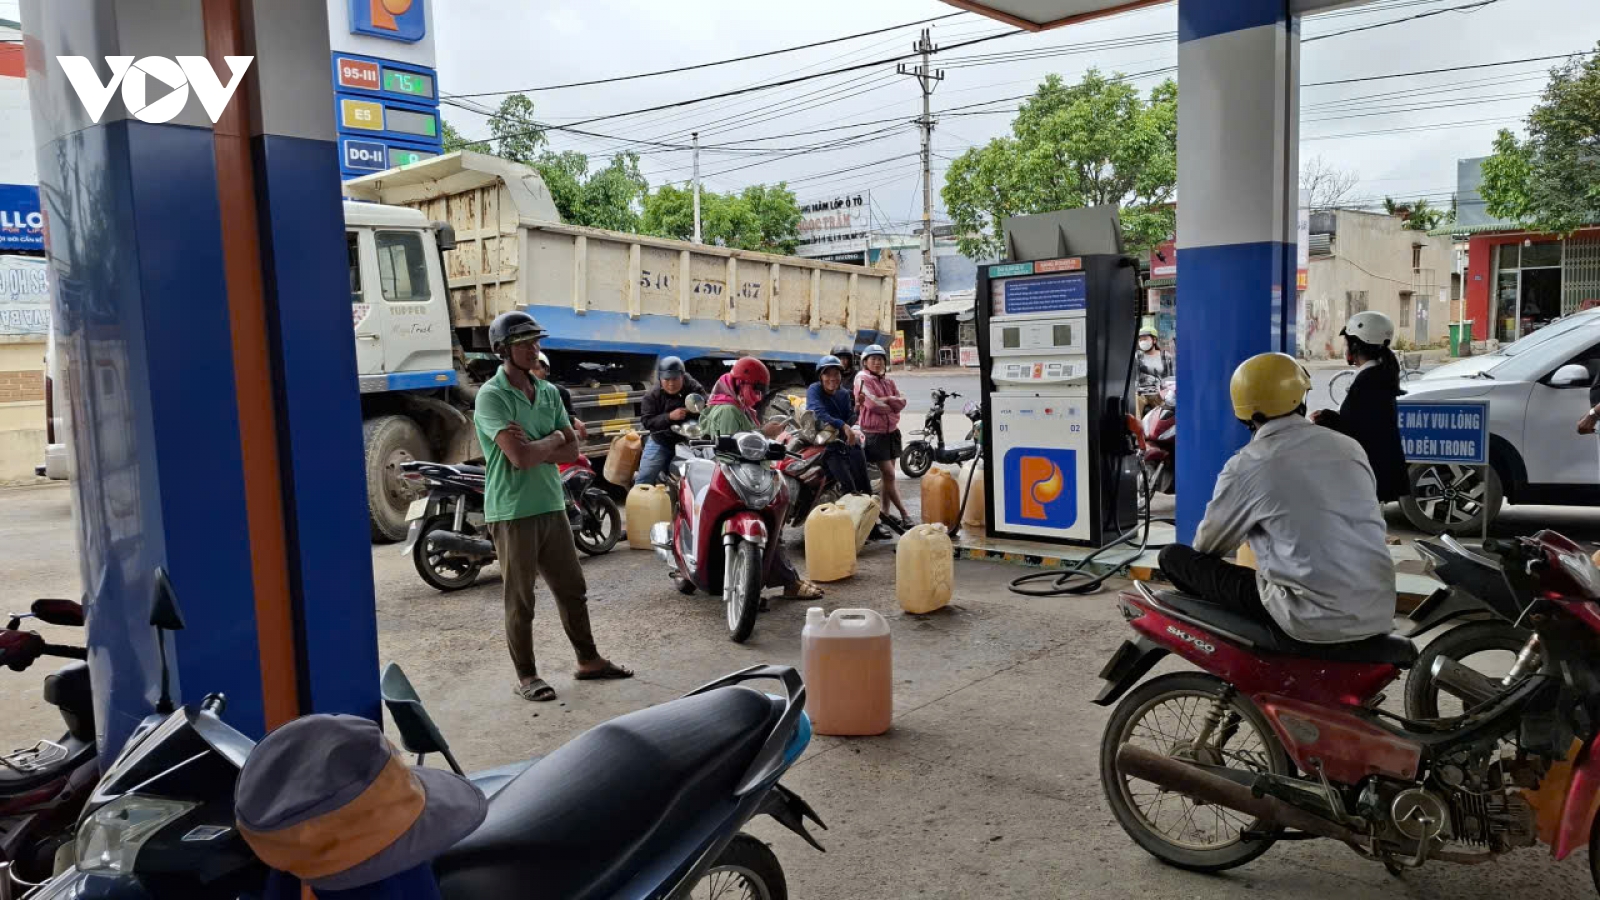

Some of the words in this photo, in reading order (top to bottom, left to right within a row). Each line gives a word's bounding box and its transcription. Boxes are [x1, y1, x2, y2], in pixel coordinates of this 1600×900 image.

[343, 66, 376, 82] 95-III
[350, 147, 382, 162] DO-II
[1000, 424, 1009, 432] 01
[1070, 424, 1080, 432] 02
[1405, 409, 1430, 429] MÁY
[1431, 413, 1449, 430] VUI
[1450, 409, 1480, 430] LÒNG
[1415, 436, 1437, 456] BÊN
[1439, 439, 1475, 456] TRONG
[1166, 625, 1215, 653] SKYGO
